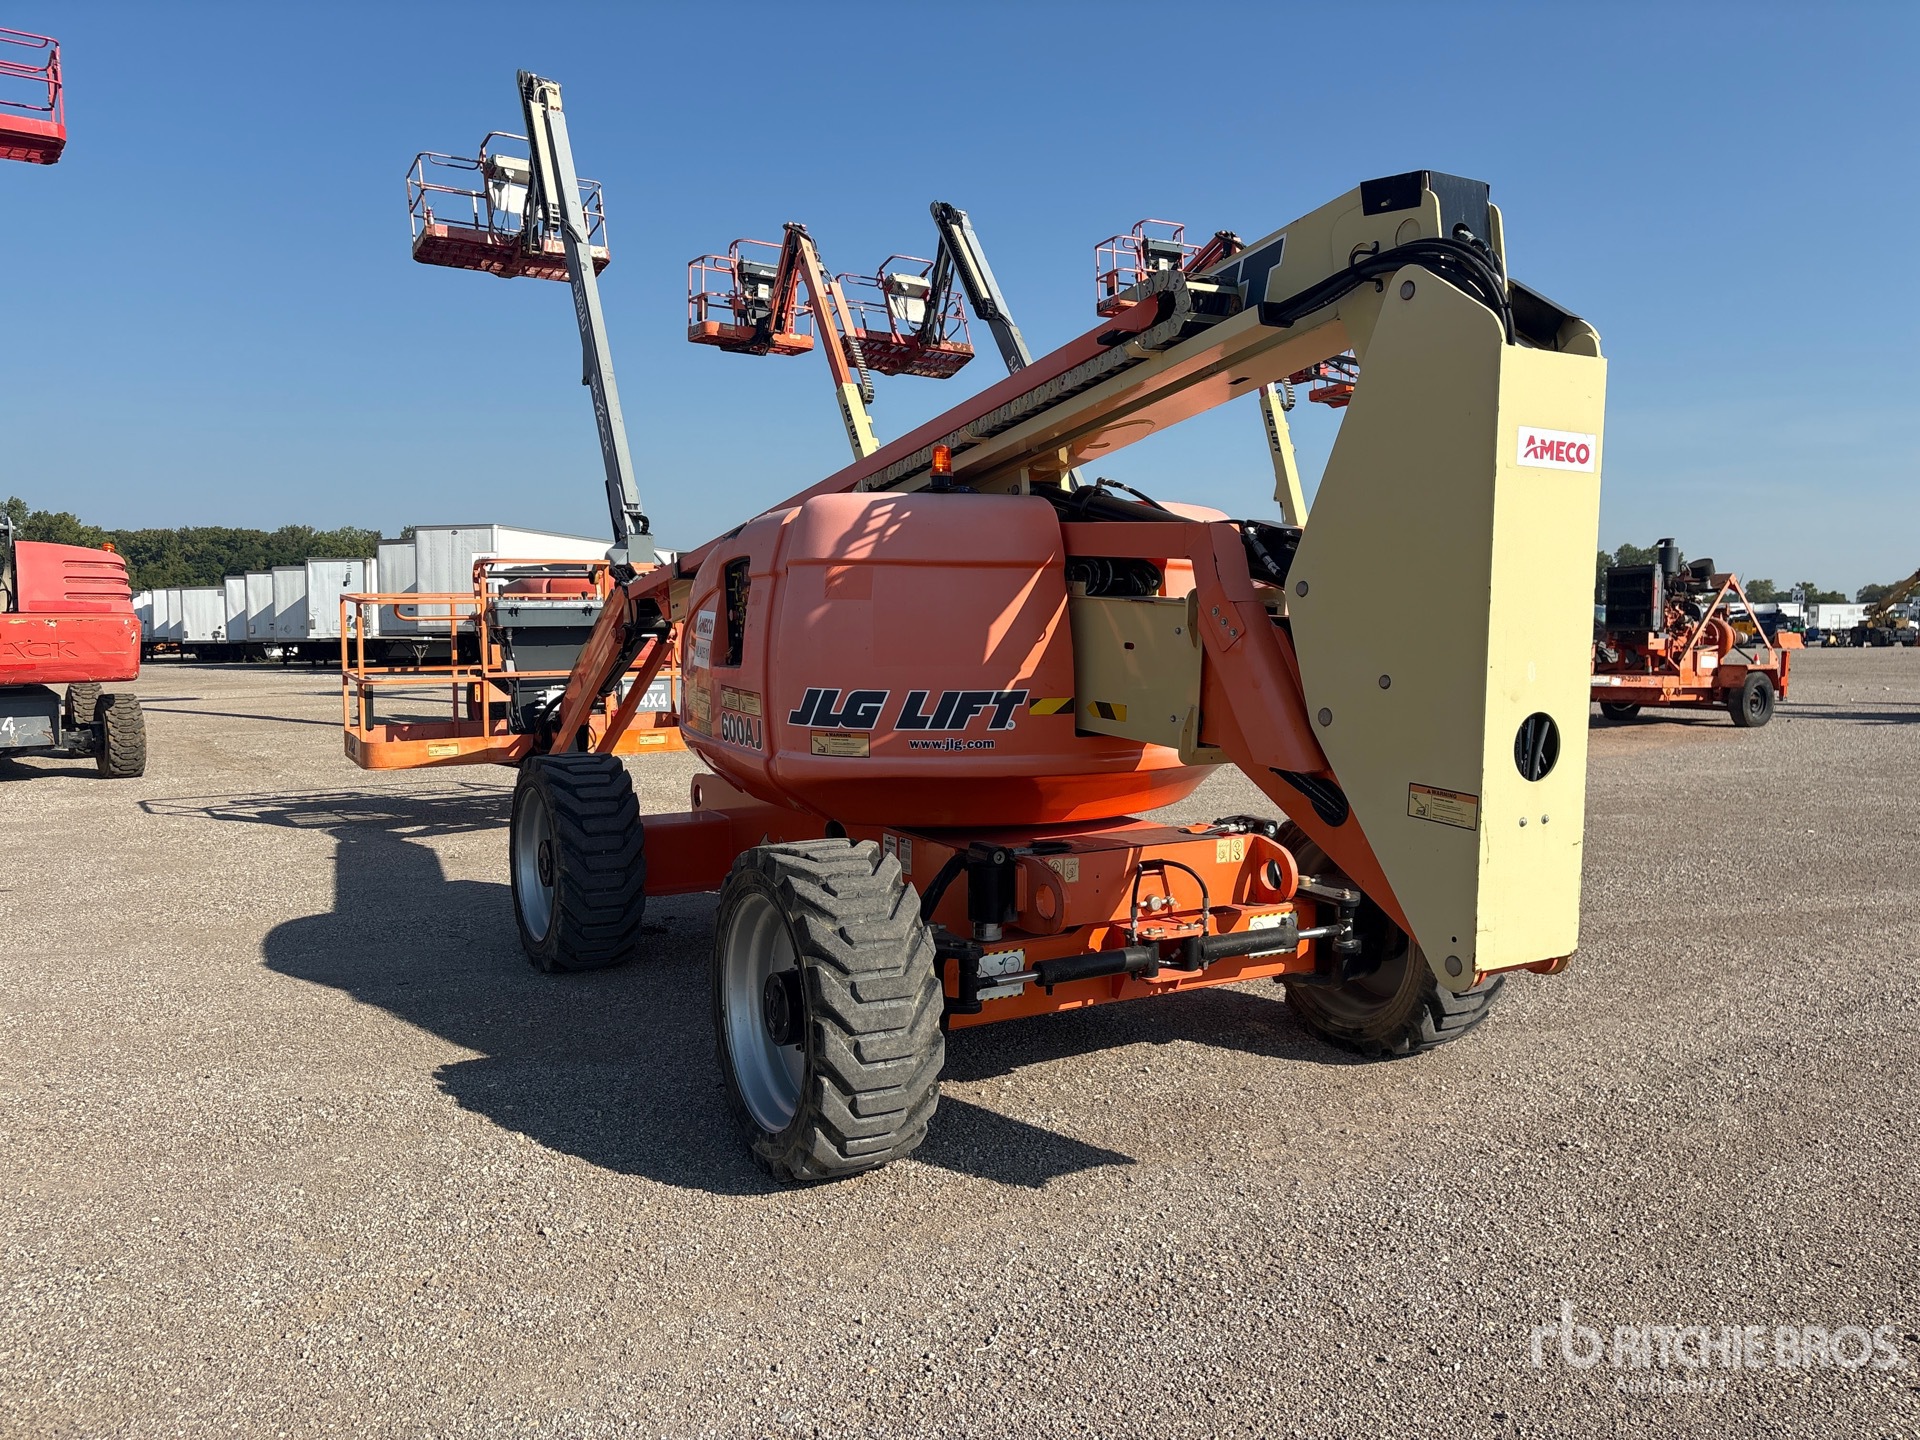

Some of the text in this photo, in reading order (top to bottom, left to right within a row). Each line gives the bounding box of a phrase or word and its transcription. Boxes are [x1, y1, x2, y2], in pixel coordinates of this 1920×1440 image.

[573, 280, 588, 332] SJ63AJ
[591, 373, 609, 452] SKYJACK
[843, 403, 860, 447] JLG LIFT
[1265, 409, 1281, 453] JLG LIFT
[1523, 435, 1590, 464] AMECO
[1793, 593, 1804, 601] 44
[696, 615, 714, 634] AMECO
[640, 692, 668, 708] 4X4
[787, 687, 890, 730] JLG
[894, 689, 1030, 731] LIFT
[0, 716, 16, 738] 4
[720, 711, 764, 751] 600AJ
[909, 738, 995, 751] www.jlg.com
[1432, 789, 1457, 799] WARNING
